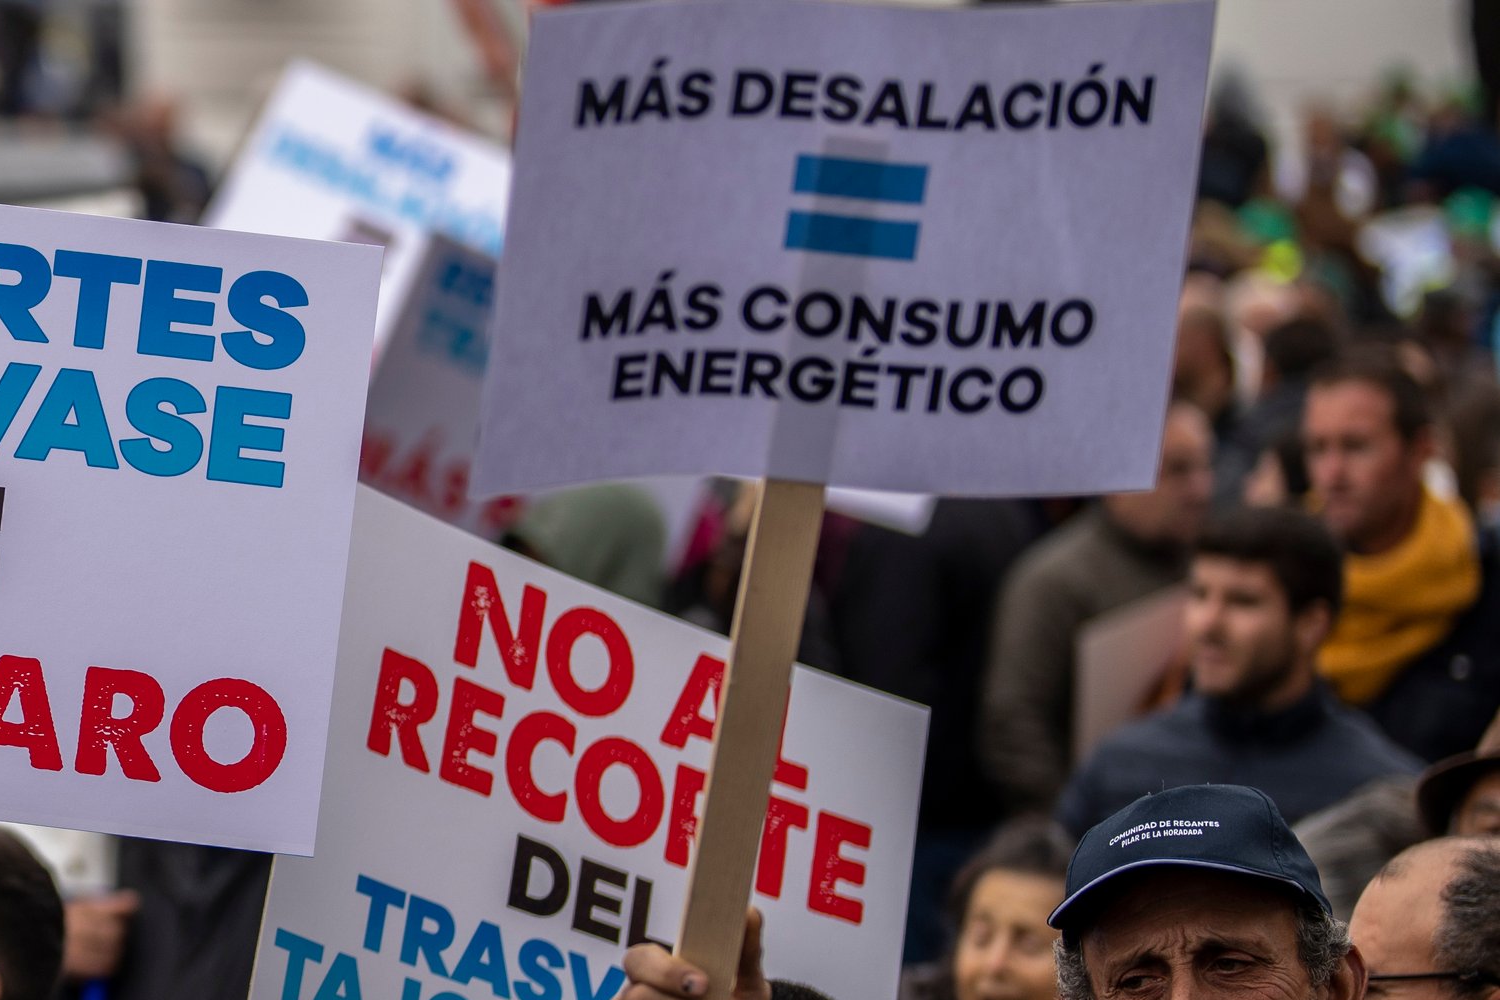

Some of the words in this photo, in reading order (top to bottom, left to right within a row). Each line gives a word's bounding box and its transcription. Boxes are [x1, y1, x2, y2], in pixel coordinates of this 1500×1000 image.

[576, 59, 713, 126] MÁS
[731, 64, 1154, 130] DESALACIÓN
[581, 270, 721, 340] MÁS
[742, 286, 1094, 349] CONSUMO
[613, 347, 1044, 414] ENERGÉTICO
[454, 561, 635, 718] NO
[1108, 821, 1157, 846] COMUNIDAD
[1173, 820, 1220, 828] REGANTES
[1121, 835, 1140, 848] PILAR
[1141, 832, 1150, 840] DE
[1152, 830, 1161, 838] LA
[1163, 829, 1203, 837] HORADADA
[508, 834, 673, 954] DEL
